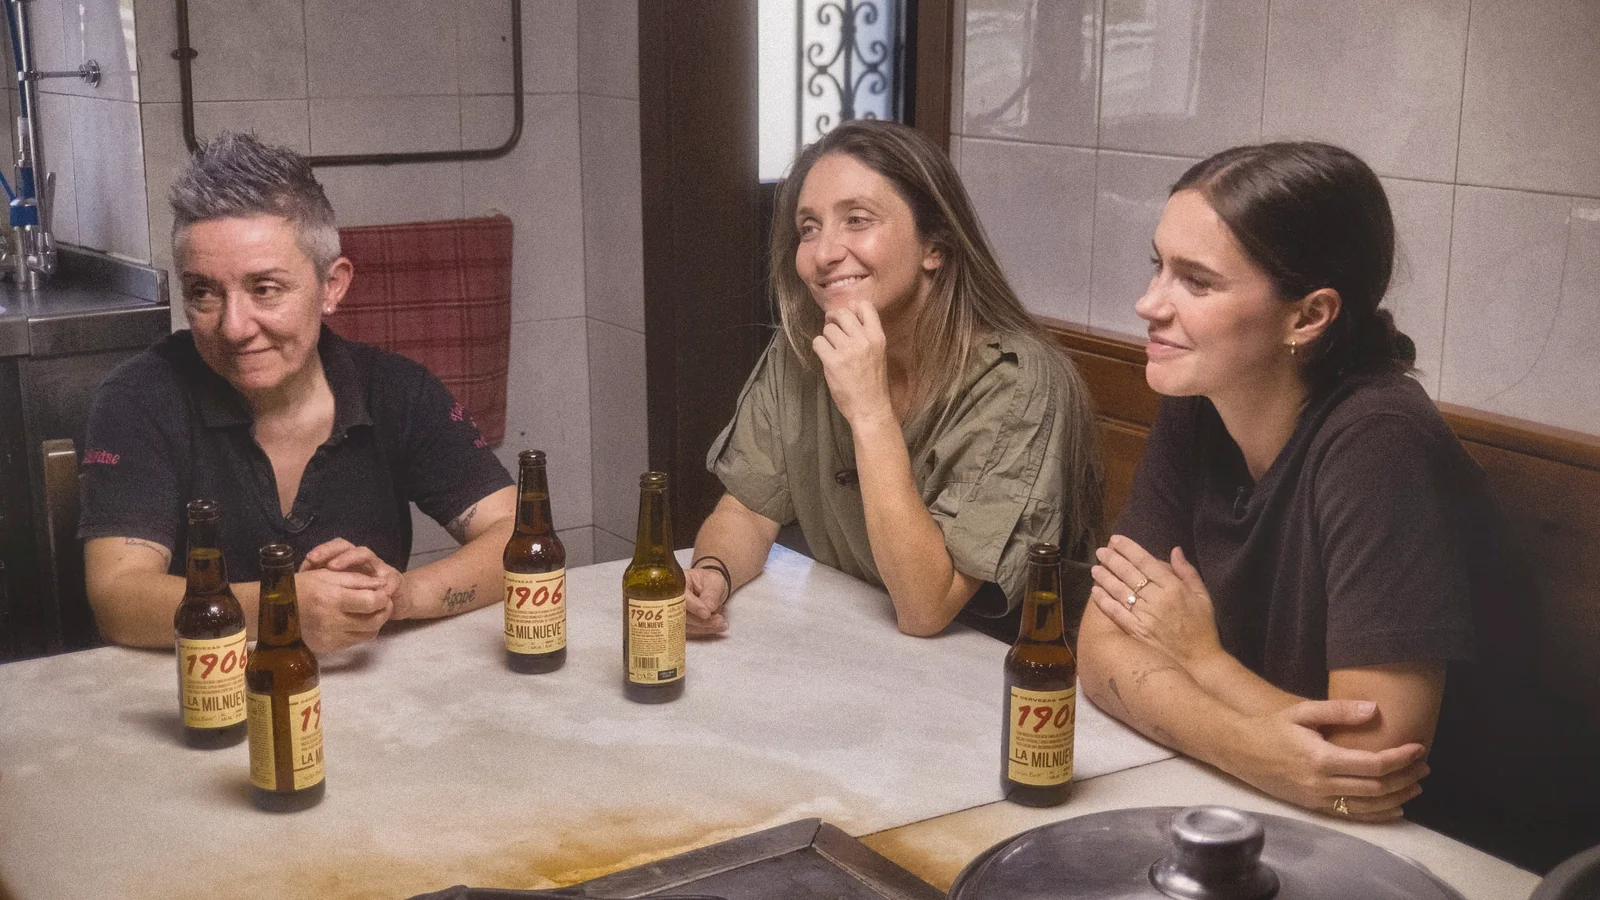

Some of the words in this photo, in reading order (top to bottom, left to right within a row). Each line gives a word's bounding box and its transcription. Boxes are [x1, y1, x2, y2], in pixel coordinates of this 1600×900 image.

[506, 580, 563, 609] 1906
[631, 609, 664, 621] 1906
[506, 622, 514, 633] LA
[516, 621, 561, 639] MILNUEVE
[187, 696, 199, 706] LA
[202, 690, 245, 712] MILNUEV
[1020, 695, 1056, 703] CERVEZAS
[301, 699, 321, 732] 19
[302, 752, 313, 765] LA
[1015, 748, 1028, 761] LA
